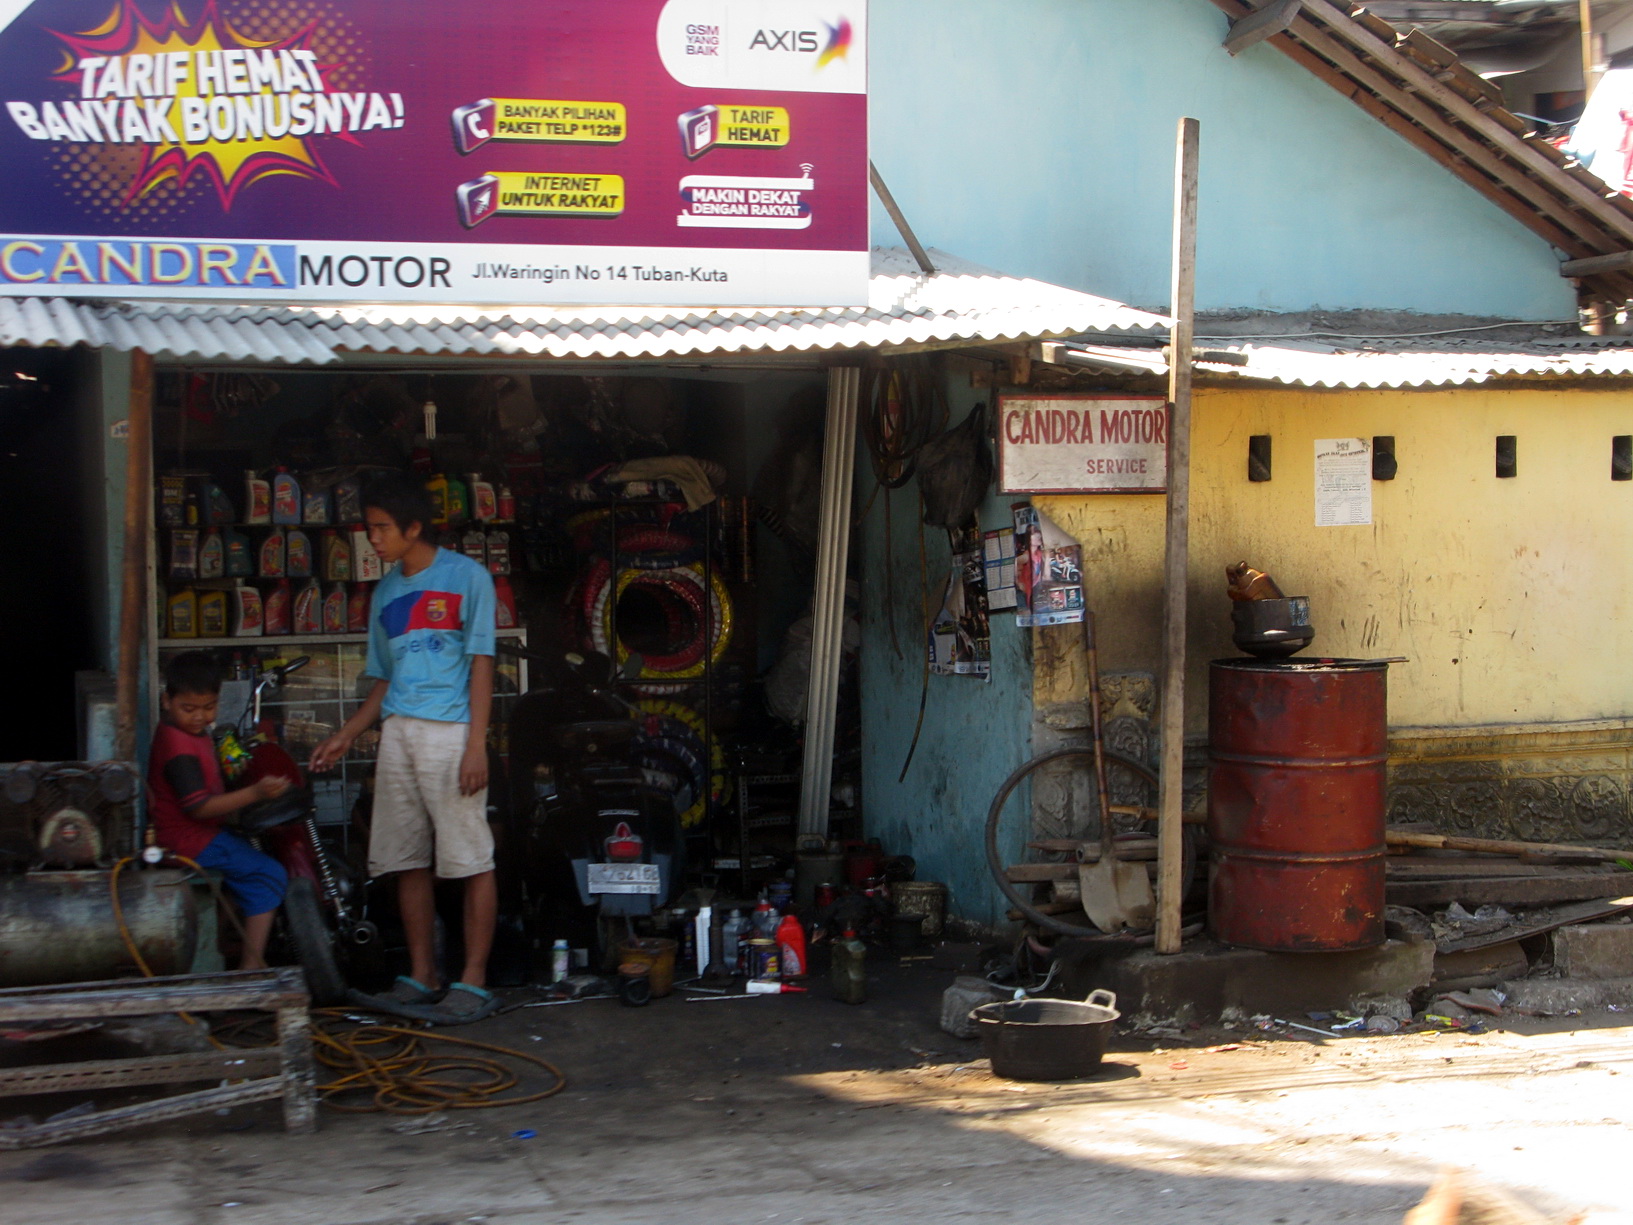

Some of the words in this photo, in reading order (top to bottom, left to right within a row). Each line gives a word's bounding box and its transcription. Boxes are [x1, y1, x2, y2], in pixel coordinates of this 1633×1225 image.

[686, 24, 719, 35] GSM
[686, 36, 719, 45] YANG
[749, 29, 818, 52] AXIS
[686, 45, 719, 56] BAIK
[78, 51, 191, 98] TARIF
[199, 49, 324, 95] HEMAT
[7, 98, 180, 143] BANYAK
[181, 93, 405, 142] BONUSNYA!
[504, 105, 560, 118] BANYAK
[562, 107, 616, 120] PILIHAN
[730, 109, 775, 124] TARIF
[498, 121, 542, 134] PAKET
[545, 122, 579, 135] TELP
[728, 127, 781, 142] HEMAT
[525, 176, 602, 191] INTERNET
[501, 192, 556, 206] UNTUK
[558, 193, 619, 209] RAKYAT
[692, 188, 746, 203] MAKIN
[748, 190, 801, 205] DEKAT
[692, 203, 749, 215] DENGAN
[750, 205, 801, 216] RAKYAT
[0, 241, 288, 285] CANDRA
[300, 255, 451, 288] MOTOR
[472, 263, 570, 283] Jl.Waringin
[575, 265, 600, 280] No
[606, 266, 628, 280] 14
[632, 266, 728, 282] Tuban-Kuta
[1006, 410, 1094, 444] CANDRA
[1100, 409, 1166, 444] MOTOR
[1086, 458, 1148, 475] SERVICE
